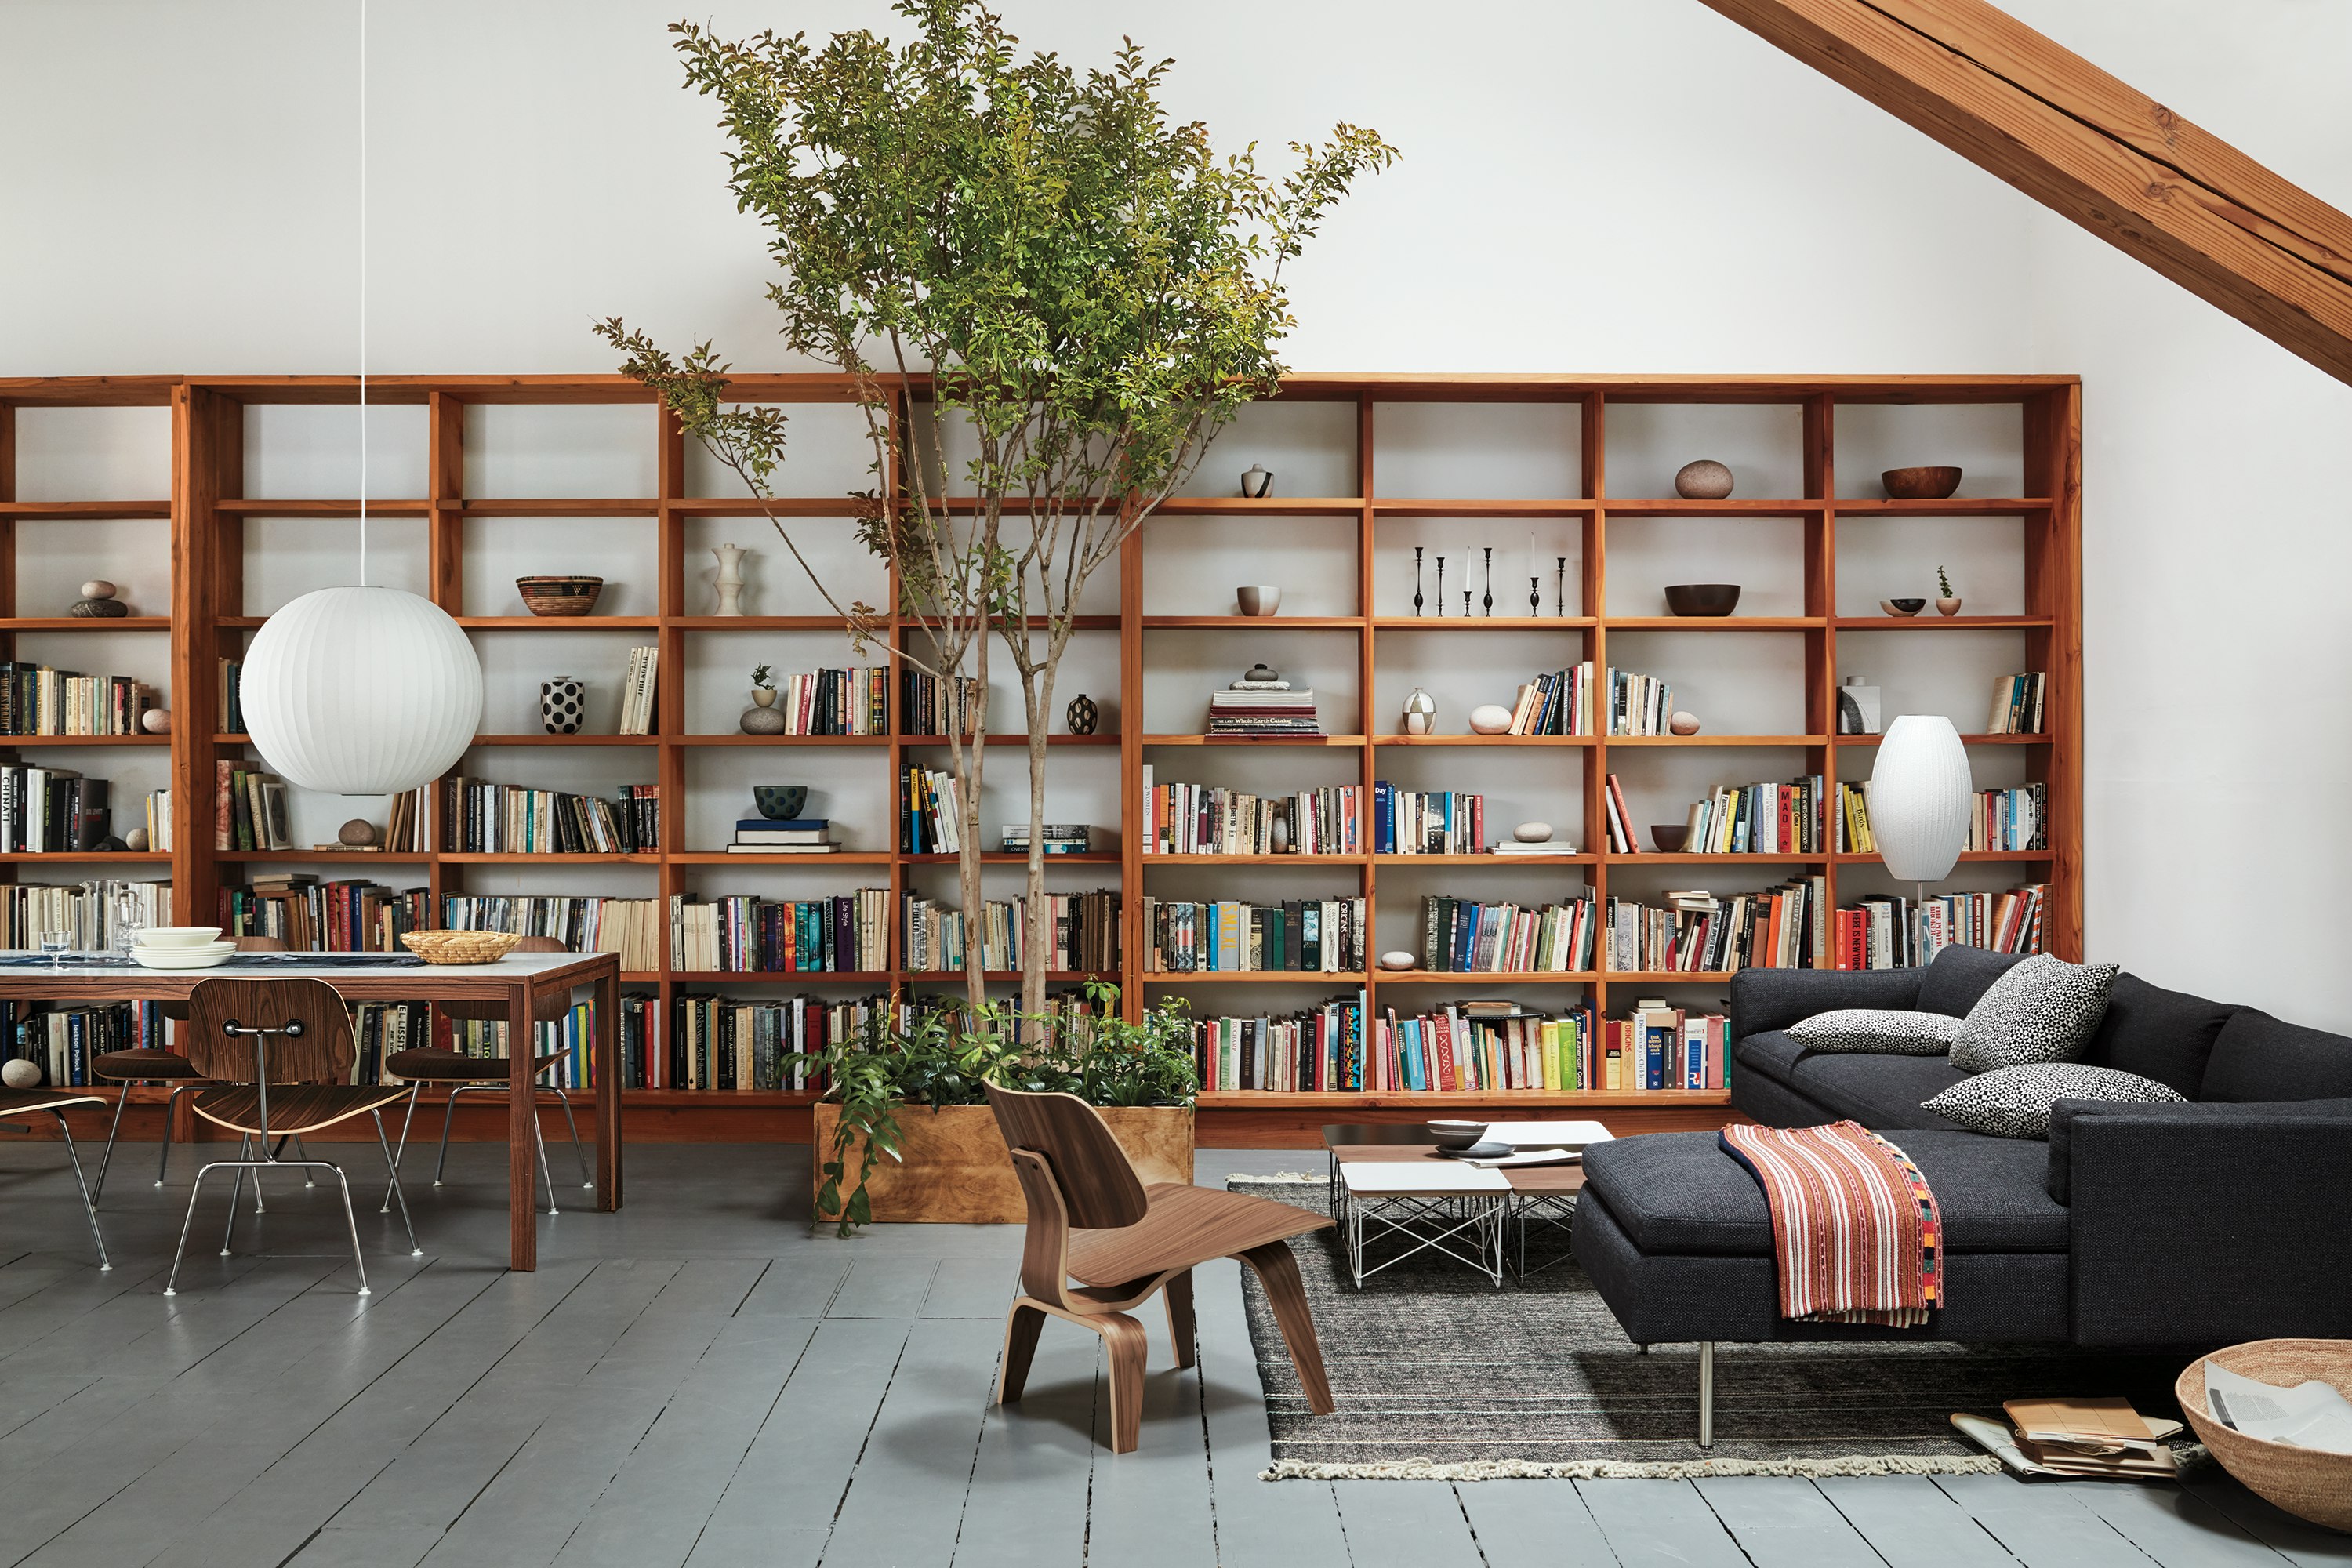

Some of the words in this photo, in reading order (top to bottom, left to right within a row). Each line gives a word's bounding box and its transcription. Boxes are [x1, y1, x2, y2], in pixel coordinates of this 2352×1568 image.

[0, 703, 9, 730] PROJECT
[249, 784, 262, 839] MICHELANGELO
[1781, 792, 1790, 823] MAO
[1857, 808, 1866, 828] Birds
[1852, 913, 1860, 929] HERE
[1852, 938, 1860, 953] NEW
[1852, 953, 1861, 971] YORK
[399, 1007, 407, 1018] EL
[397, 1021, 406, 1054] LISSITZ
